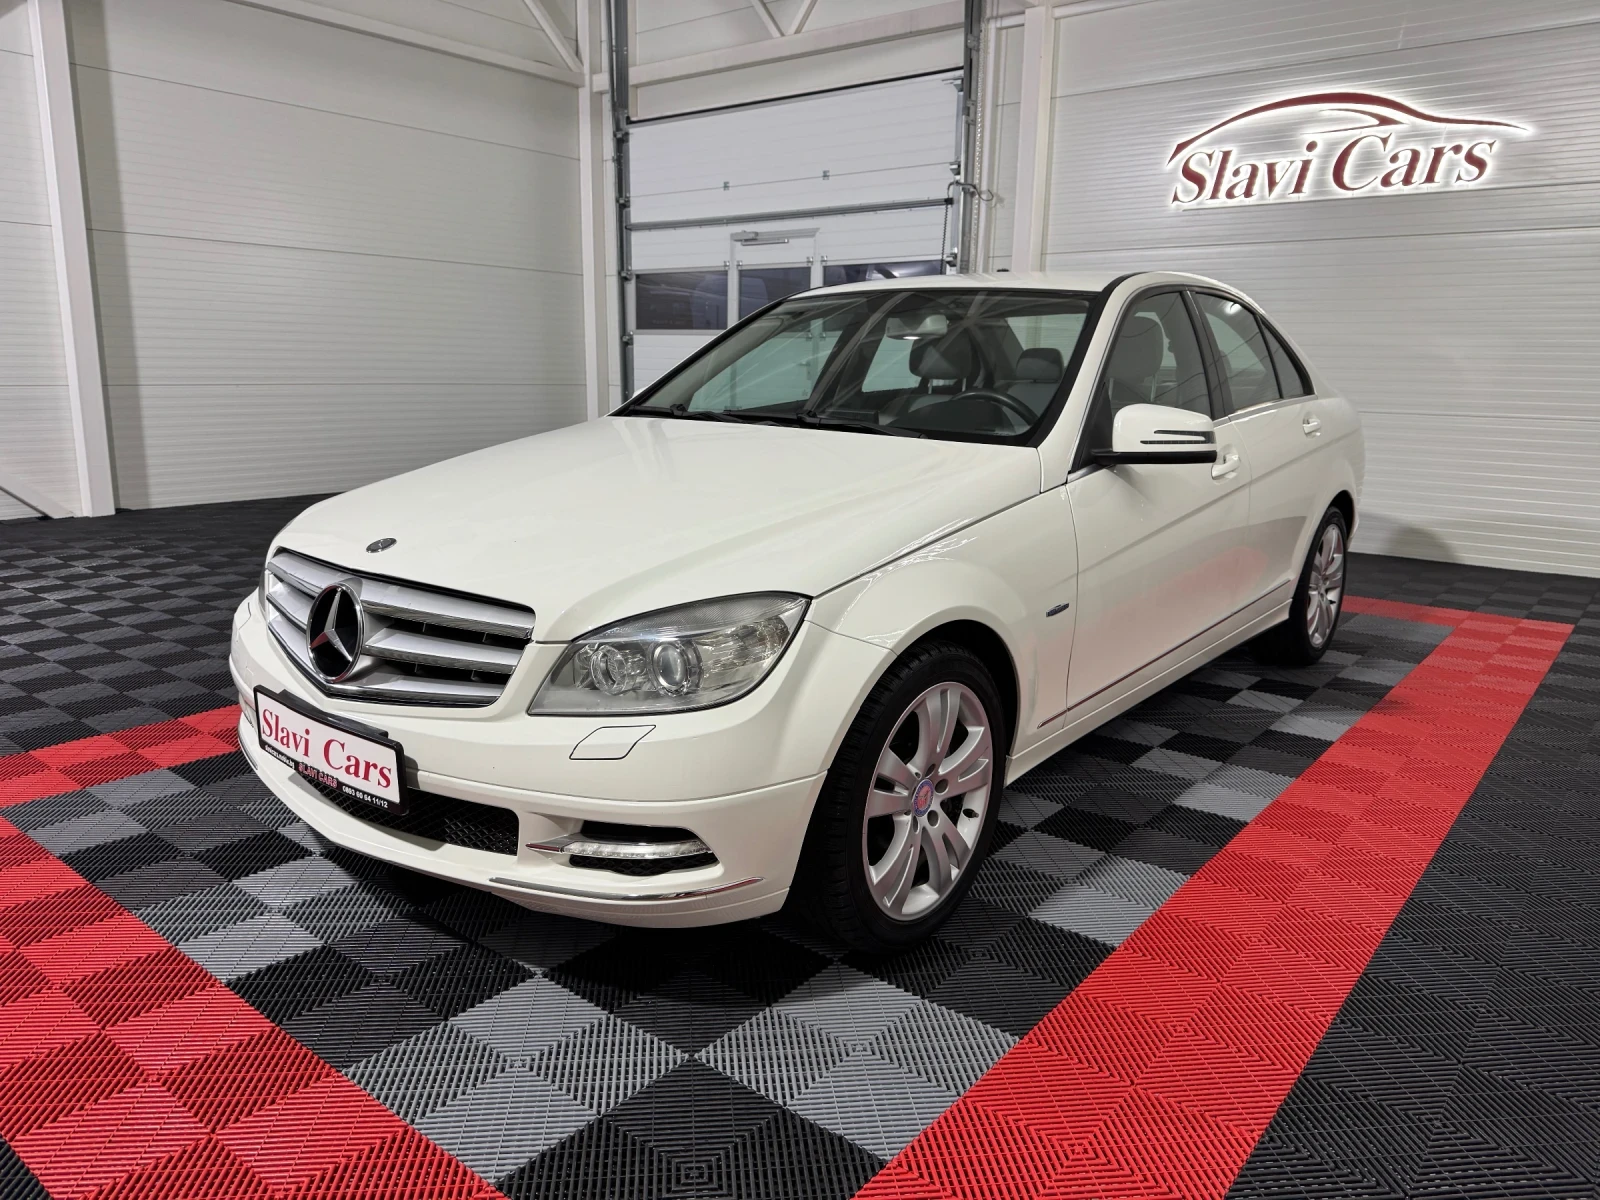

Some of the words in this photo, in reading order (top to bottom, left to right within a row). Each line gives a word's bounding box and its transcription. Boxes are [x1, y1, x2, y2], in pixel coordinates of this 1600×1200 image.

[1171, 140, 1318, 204] Slavi
[1332, 132, 1497, 191] Cars
[262, 709, 310, 757] Slavi
[323, 738, 392, 788] Cars
[318, 772, 338, 788] CARS
[372, 797, 388, 808] 11/12
